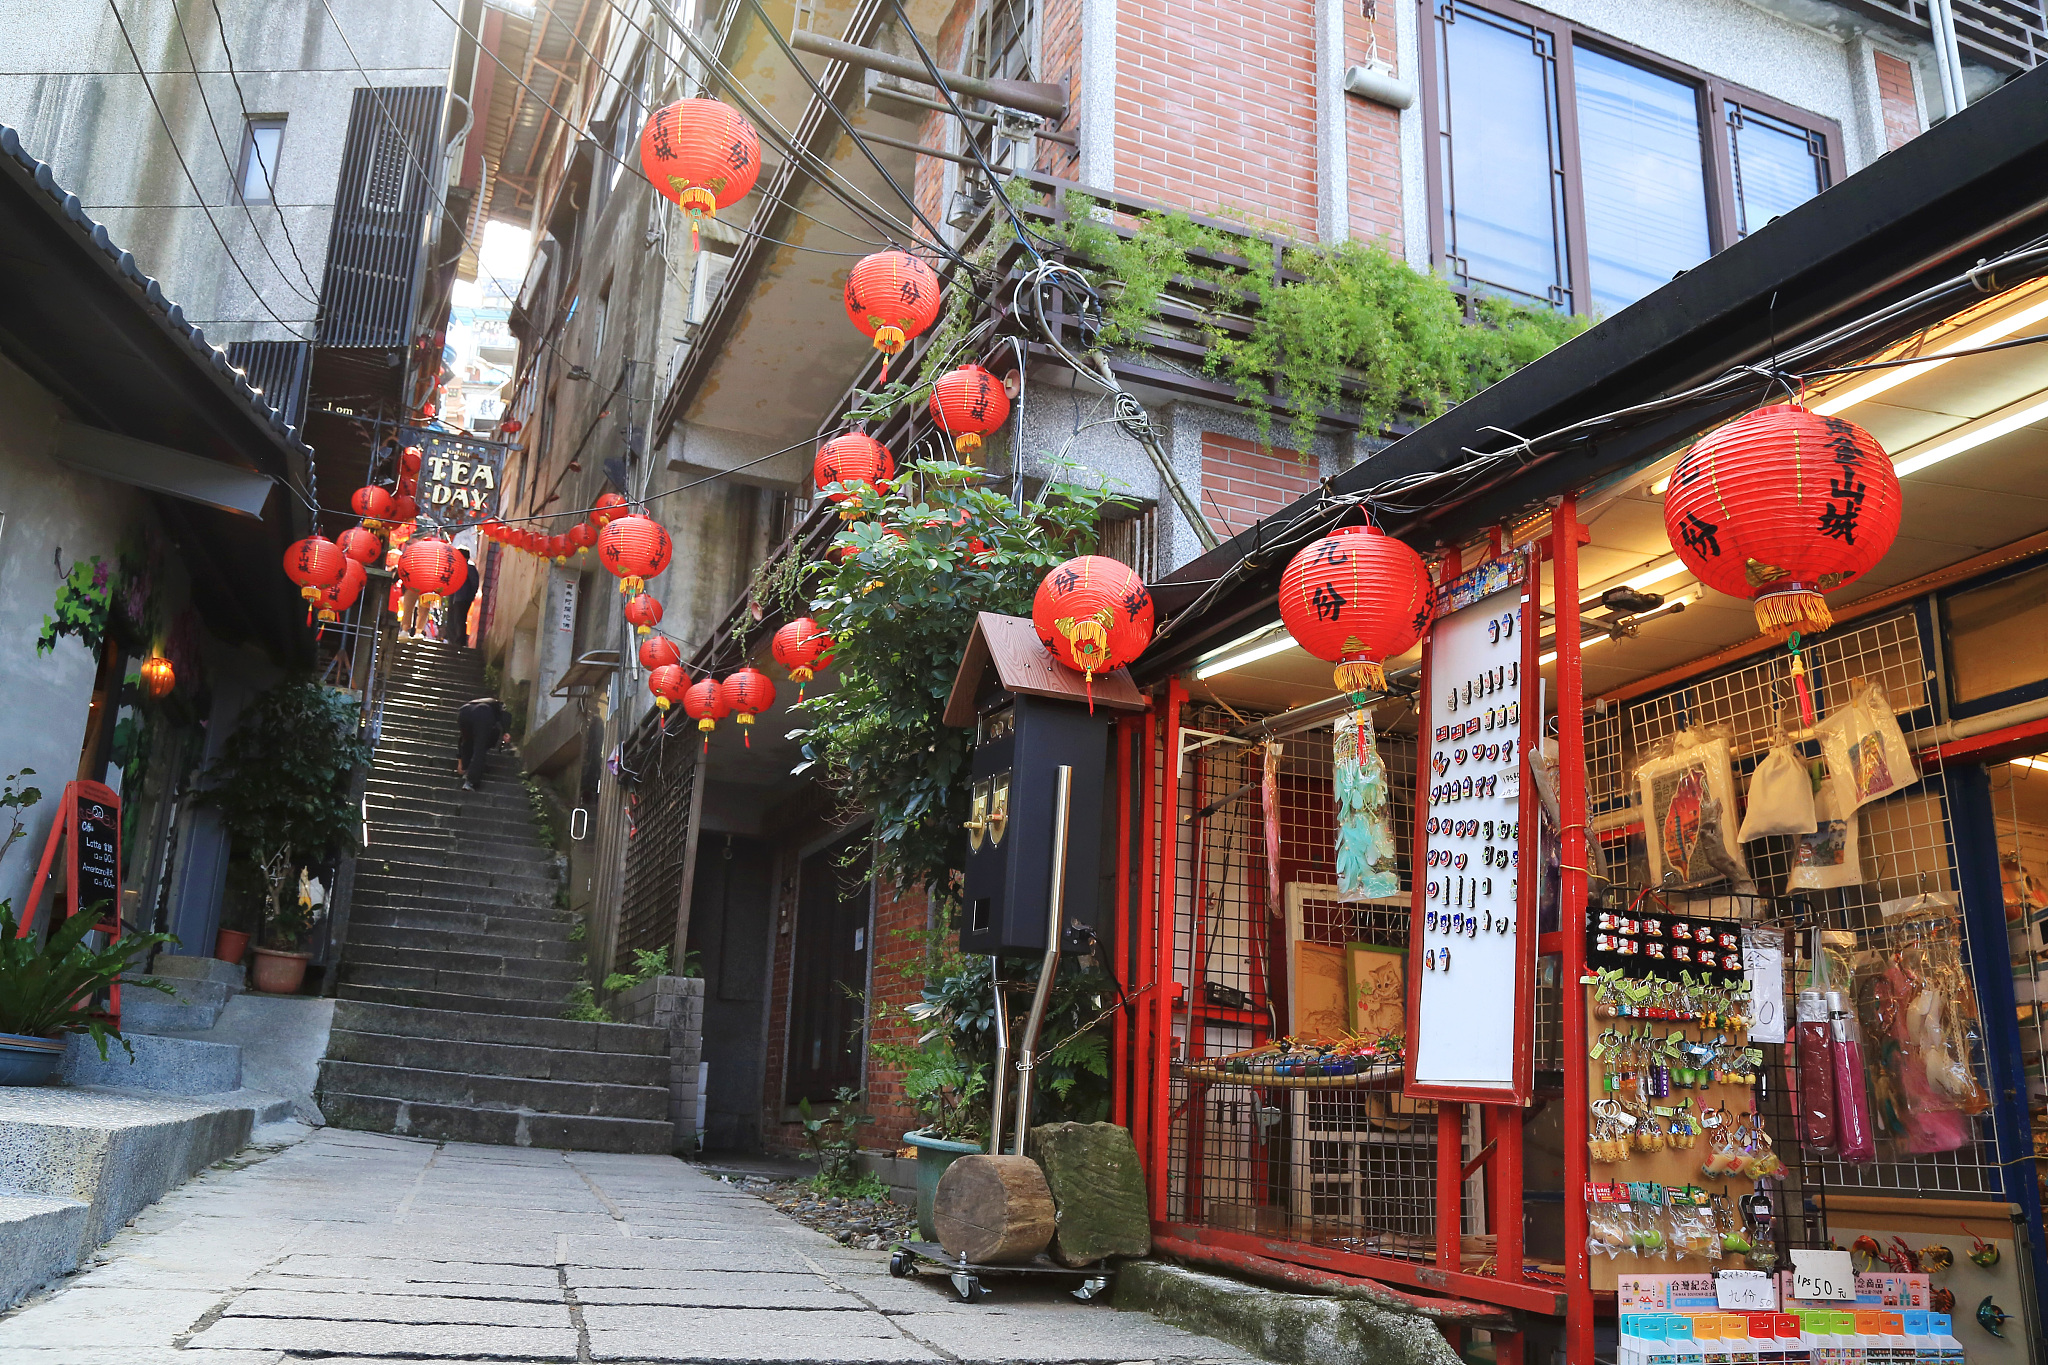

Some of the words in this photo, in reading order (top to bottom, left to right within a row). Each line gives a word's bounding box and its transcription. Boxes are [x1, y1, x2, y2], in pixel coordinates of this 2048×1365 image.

[899, 255, 925, 305] 九份
[428, 456, 495, 490] TEA
[1816, 415, 1867, 546] 黃金山城
[431, 483, 489, 511] DAY
[1312, 540, 1348, 622] 九份
[86, 837, 102, 850] Latte
[1728, 1288, 1757, 1304] 九份
[1812, 1278, 1833, 1297] 50
[1759, 1298, 1772, 1308] 50
